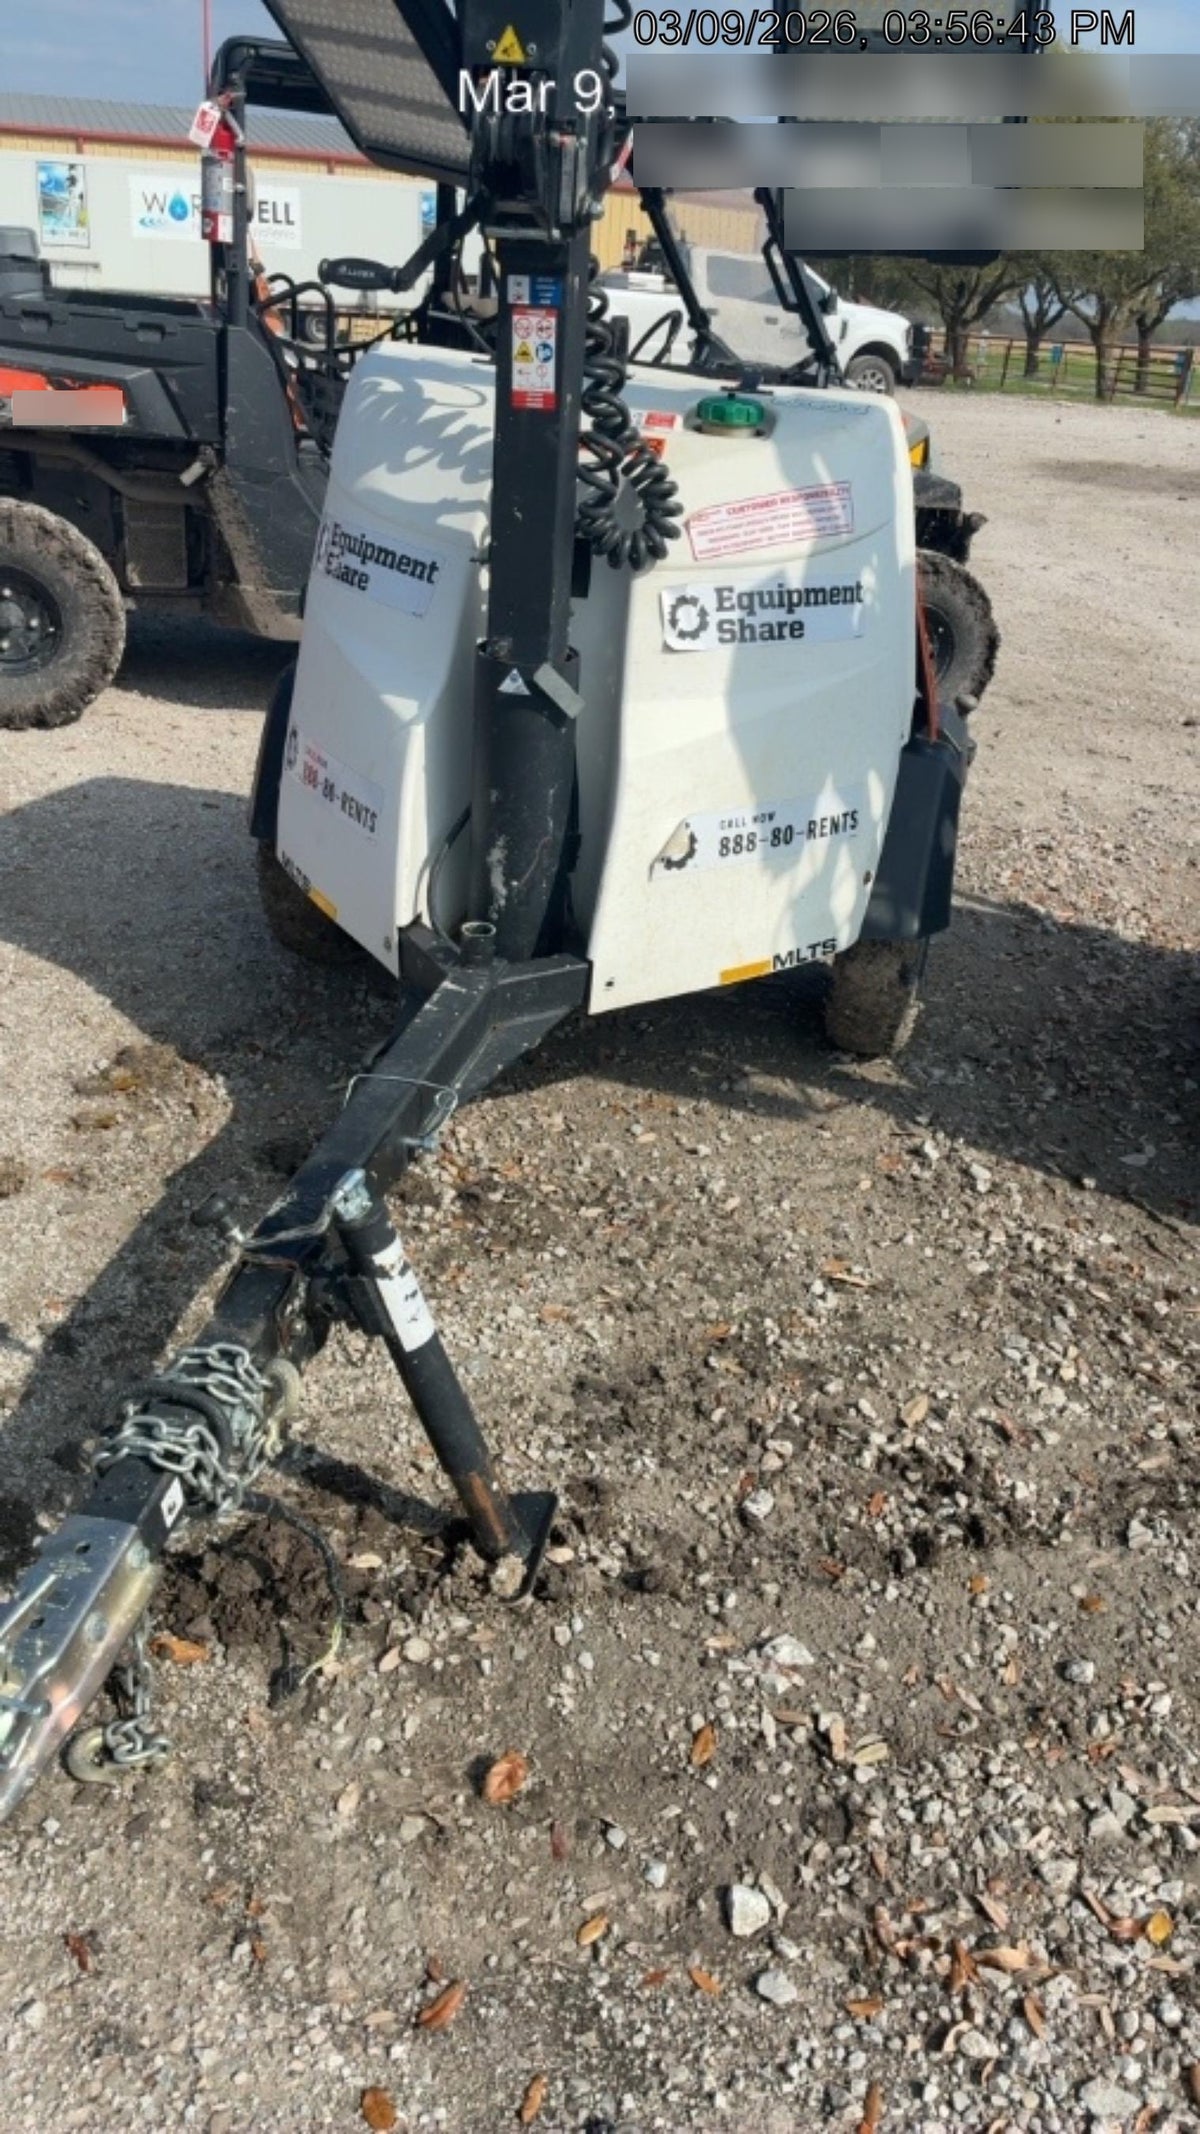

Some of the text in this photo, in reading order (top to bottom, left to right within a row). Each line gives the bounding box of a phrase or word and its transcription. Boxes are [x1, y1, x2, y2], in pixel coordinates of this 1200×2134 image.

[331, 521, 439, 584] Equipment
[714, 581, 864, 615] Equipment
[716, 620, 805, 644] Share
[718, 808, 860, 857] 888-80-RENTS
[772, 937, 838, 971] MLTS
